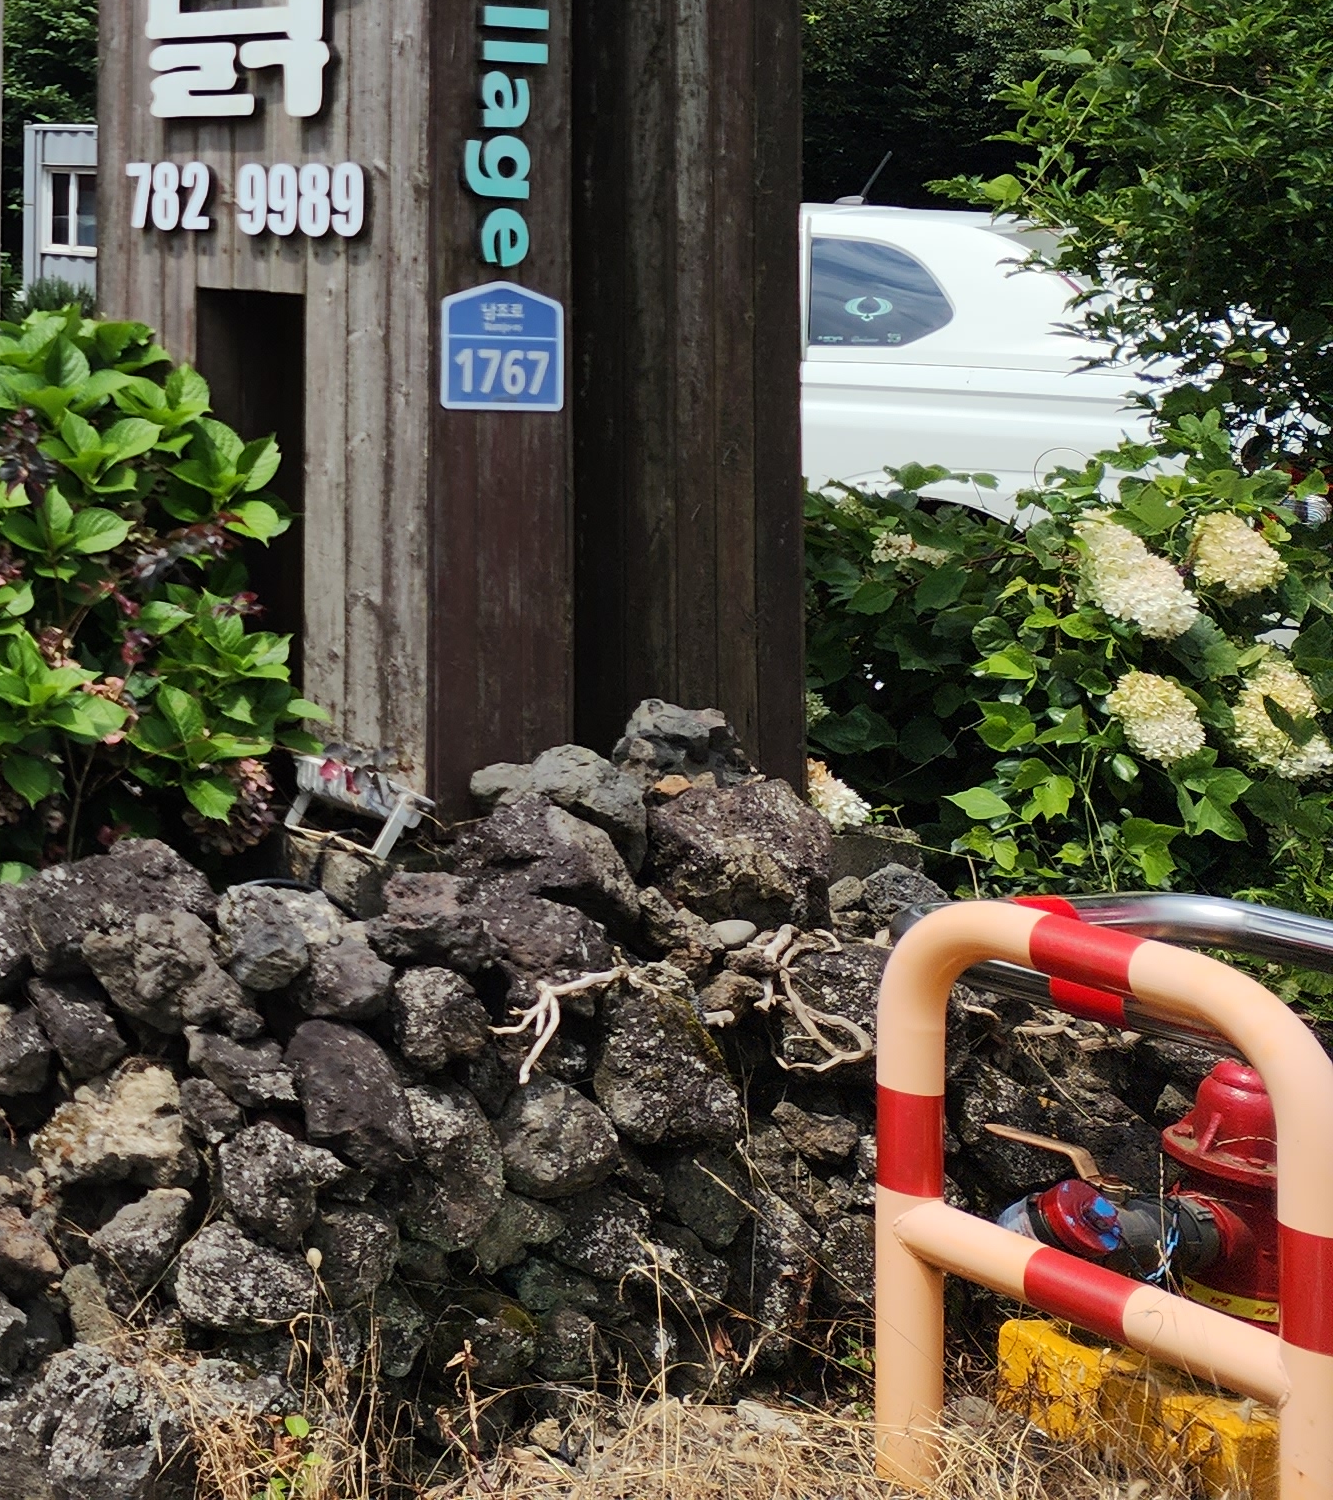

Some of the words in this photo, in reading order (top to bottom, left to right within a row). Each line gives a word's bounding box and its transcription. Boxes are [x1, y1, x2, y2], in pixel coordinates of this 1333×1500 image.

[126, 161, 210, 231] 782
[236, 161, 365, 238] 9989
[454, 347, 551, 396] 1767
